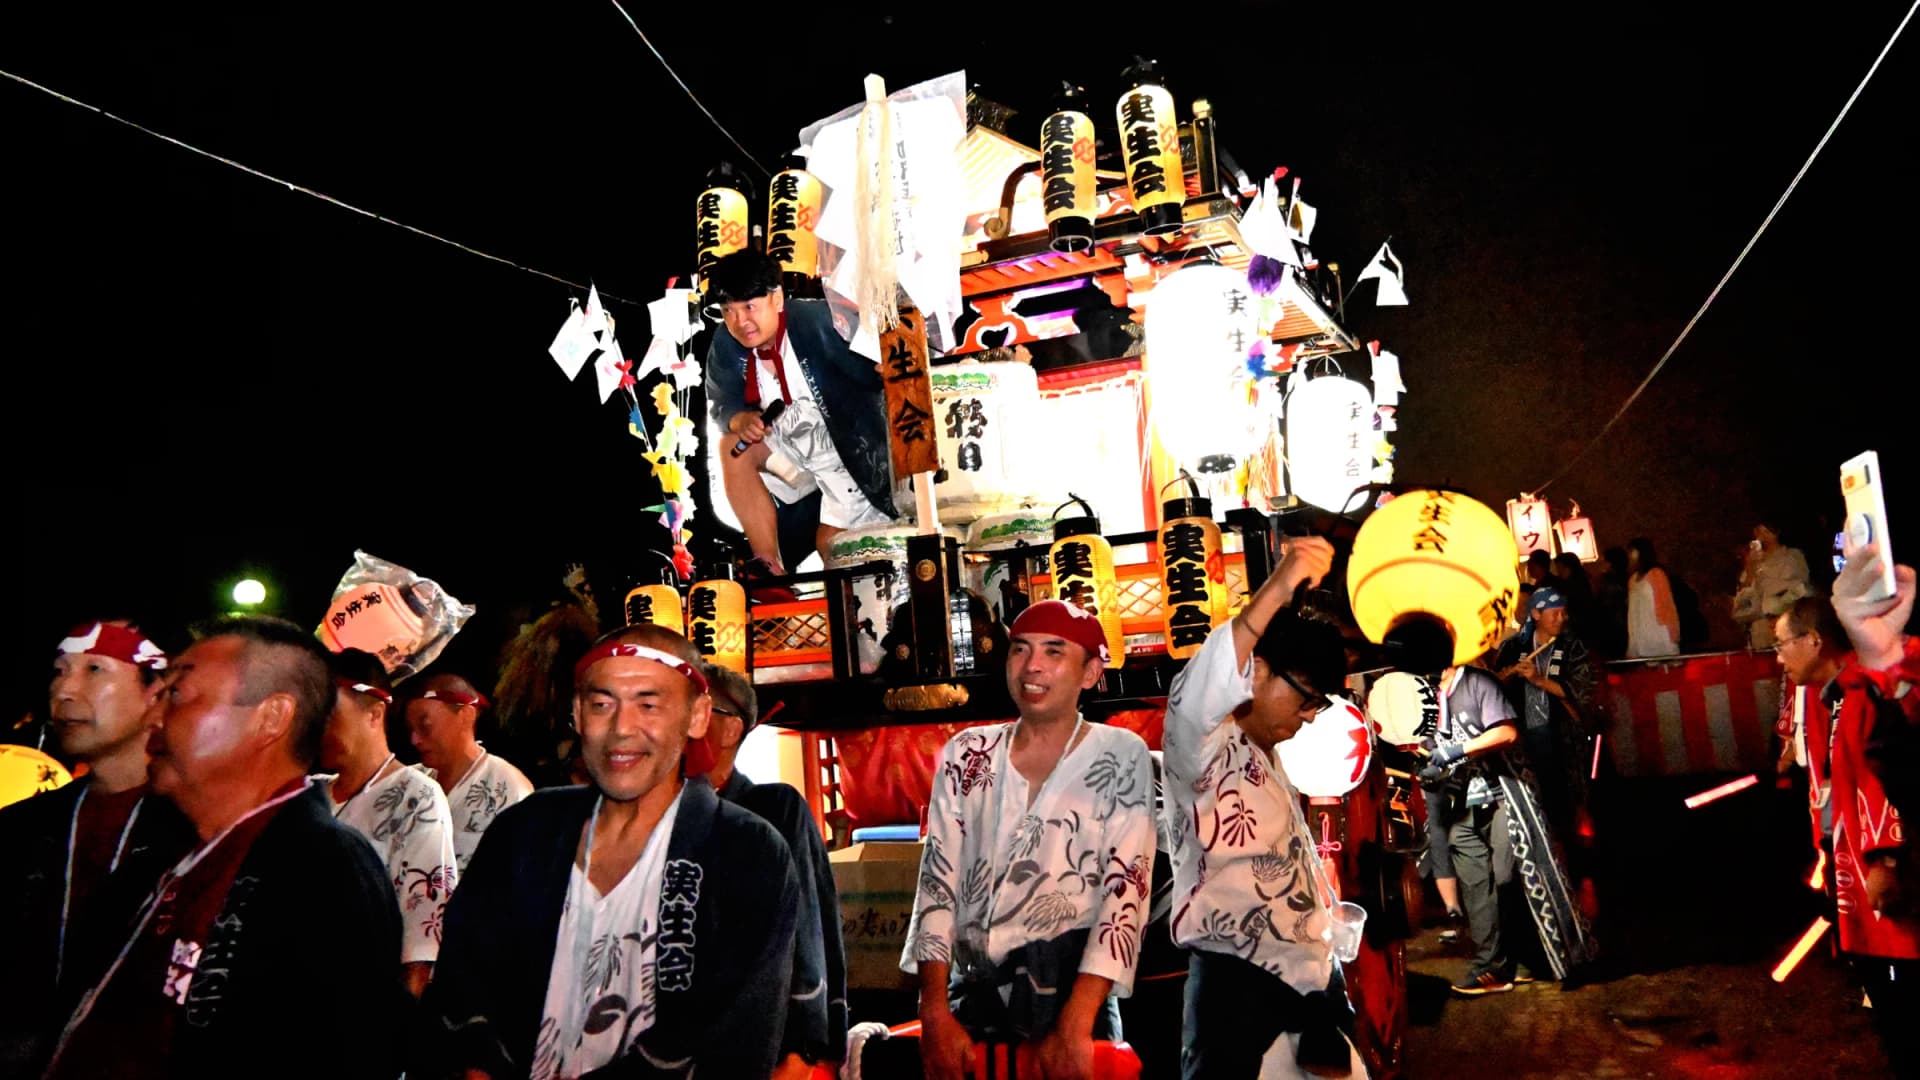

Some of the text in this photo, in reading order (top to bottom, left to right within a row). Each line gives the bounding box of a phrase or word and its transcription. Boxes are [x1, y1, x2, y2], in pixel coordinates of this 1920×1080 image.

[1043, 114, 1075, 216] 実生会
[1122, 93, 1166, 200] 実生会
[770, 174, 799, 263] 実生会
[1163, 523, 1212, 649] 実生会
[658, 859, 703, 992] 実生会
